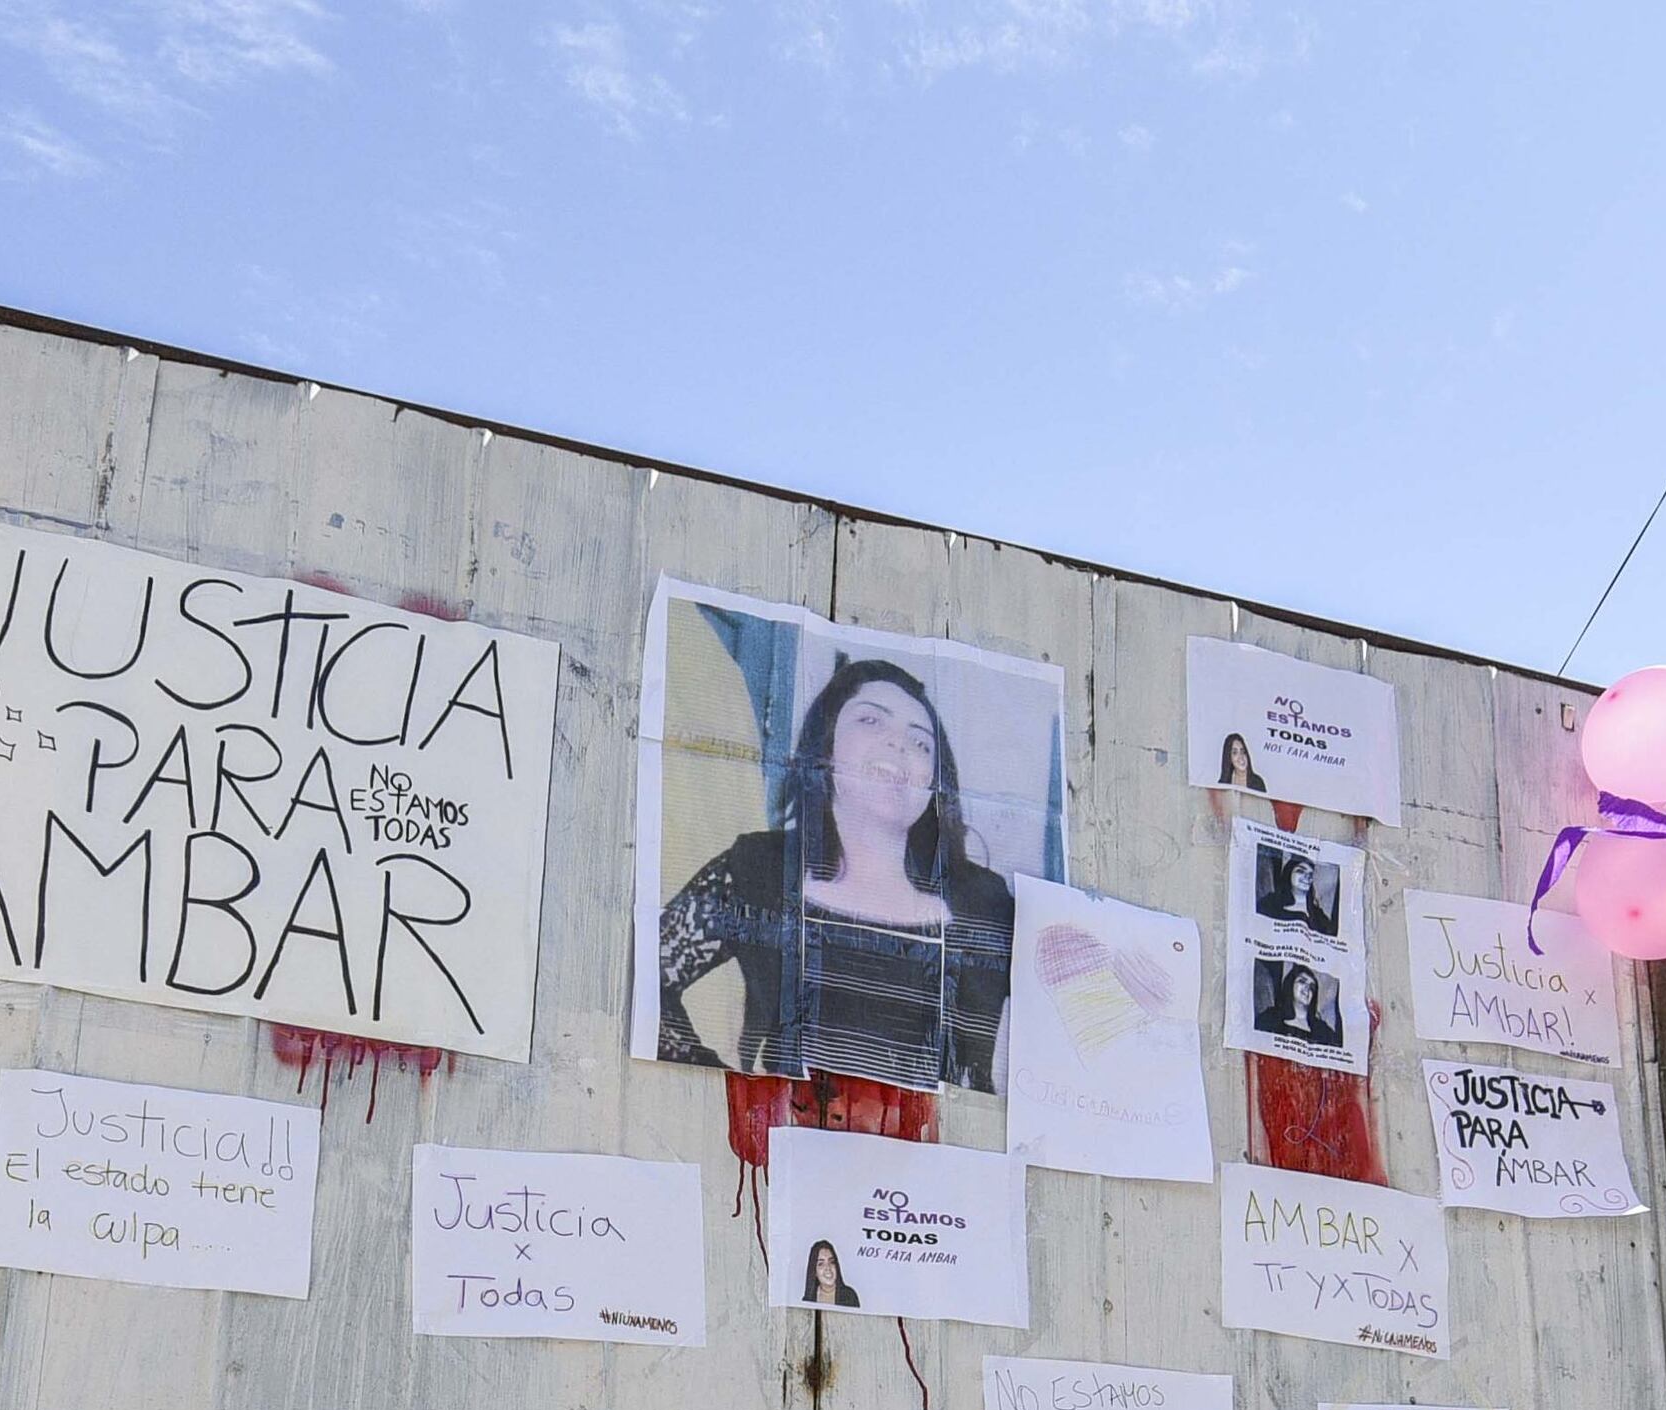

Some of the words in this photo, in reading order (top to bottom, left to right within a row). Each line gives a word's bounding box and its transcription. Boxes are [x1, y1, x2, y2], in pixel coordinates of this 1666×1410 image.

[1274, 696, 1304, 715] NO
[1266, 711, 1352, 738] ESTAMOS
[1267, 728, 1328, 750] TODAS
[55, 701, 352, 854] PARA
[370, 763, 412, 791] NO
[1313, 754, 1346, 767] AMBAR
[351, 784, 468, 826] ESTAMOS
[365, 815, 451, 850] TODAS
[1423, 916, 1569, 993] Justicia
[1453, 1068, 1579, 1120] JUSTICIA
[31, 1088, 293, 1181] Justicia!!
[1451, 1110, 1529, 1150] PARA
[6, 1148, 39, 1182] El
[65, 1160, 170, 1196] estado
[192, 1171, 276, 1209] tiene
[29, 1198, 52, 1231] la
[434, 1173, 625, 1241] Justicia
[872, 1188, 909, 1209] NO
[863, 1207, 967, 1229] ESTAMOS
[1246, 1190, 1382, 1255] AMBAR
[862, 1228, 939, 1245] TODAS
[857, 1246, 879, 1258] NOS
[885, 1249, 912, 1263] FATA
[917, 1252, 957, 1265] AMBAR
[447, 1275, 575, 1312] Todas
